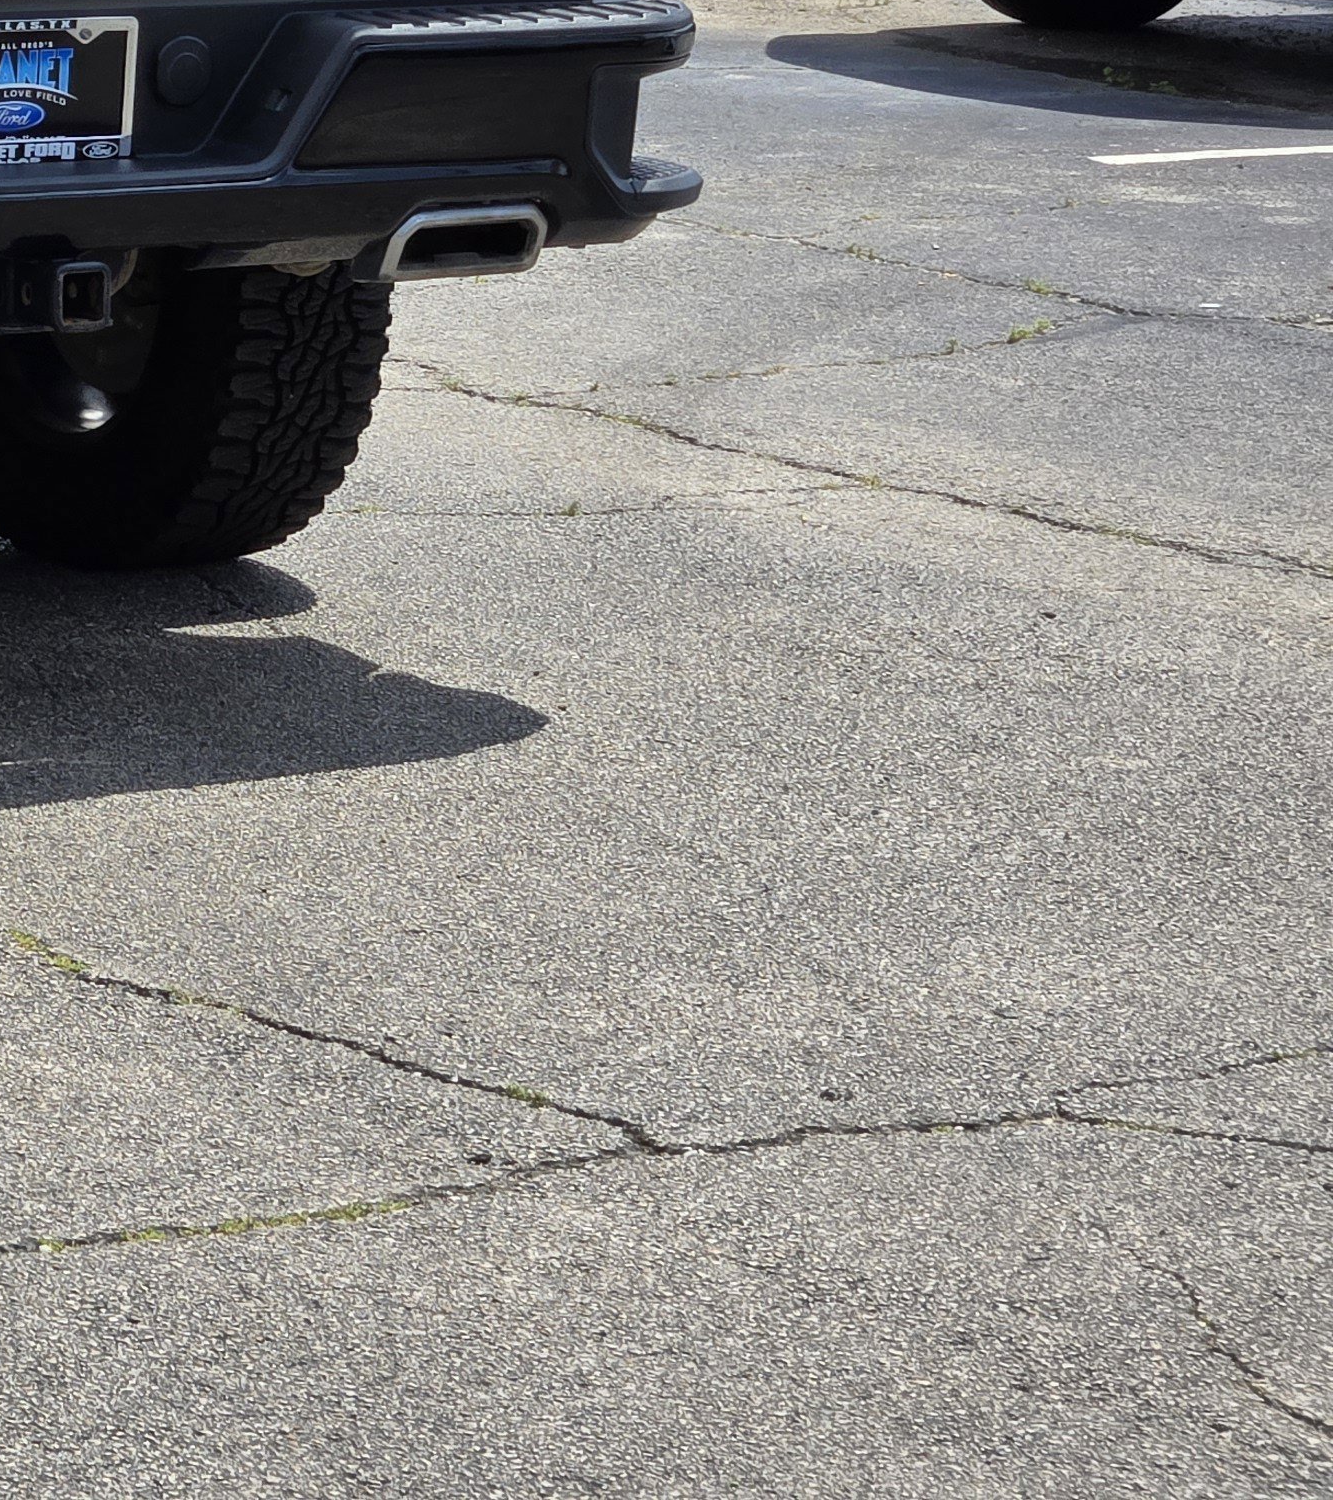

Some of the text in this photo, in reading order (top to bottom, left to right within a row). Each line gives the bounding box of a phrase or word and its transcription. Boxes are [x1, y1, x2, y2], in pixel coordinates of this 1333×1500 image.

[3, 89, 32, 99] LOVE
[36, 91, 67, 106] FIELD
[24, 142, 75, 159] FORD
